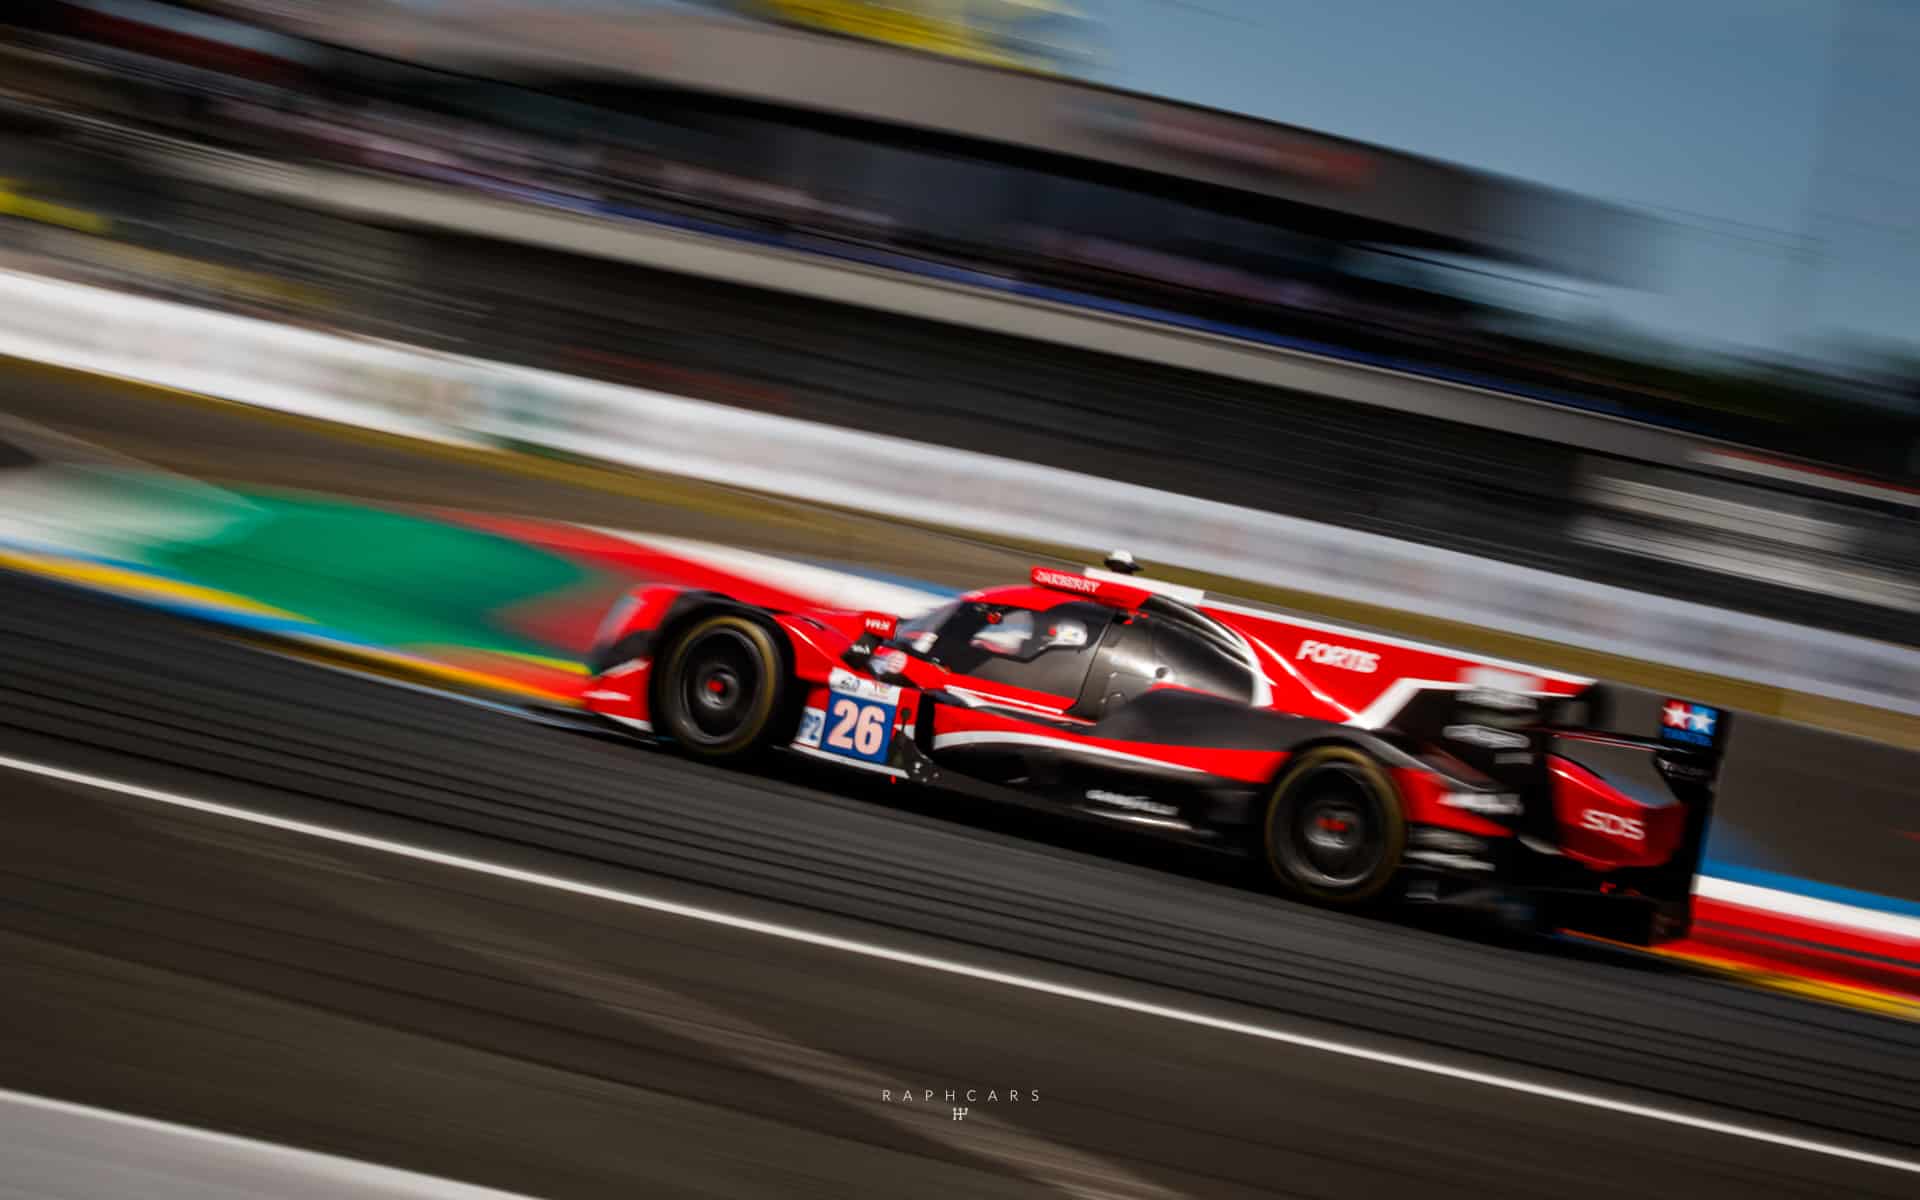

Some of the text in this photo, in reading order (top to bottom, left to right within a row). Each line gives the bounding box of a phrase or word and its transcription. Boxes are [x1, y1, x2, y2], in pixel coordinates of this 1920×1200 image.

[1296, 639, 1381, 673] FORTIS
[828, 699, 885, 755] 26
[1580, 808, 1646, 840] SDS
